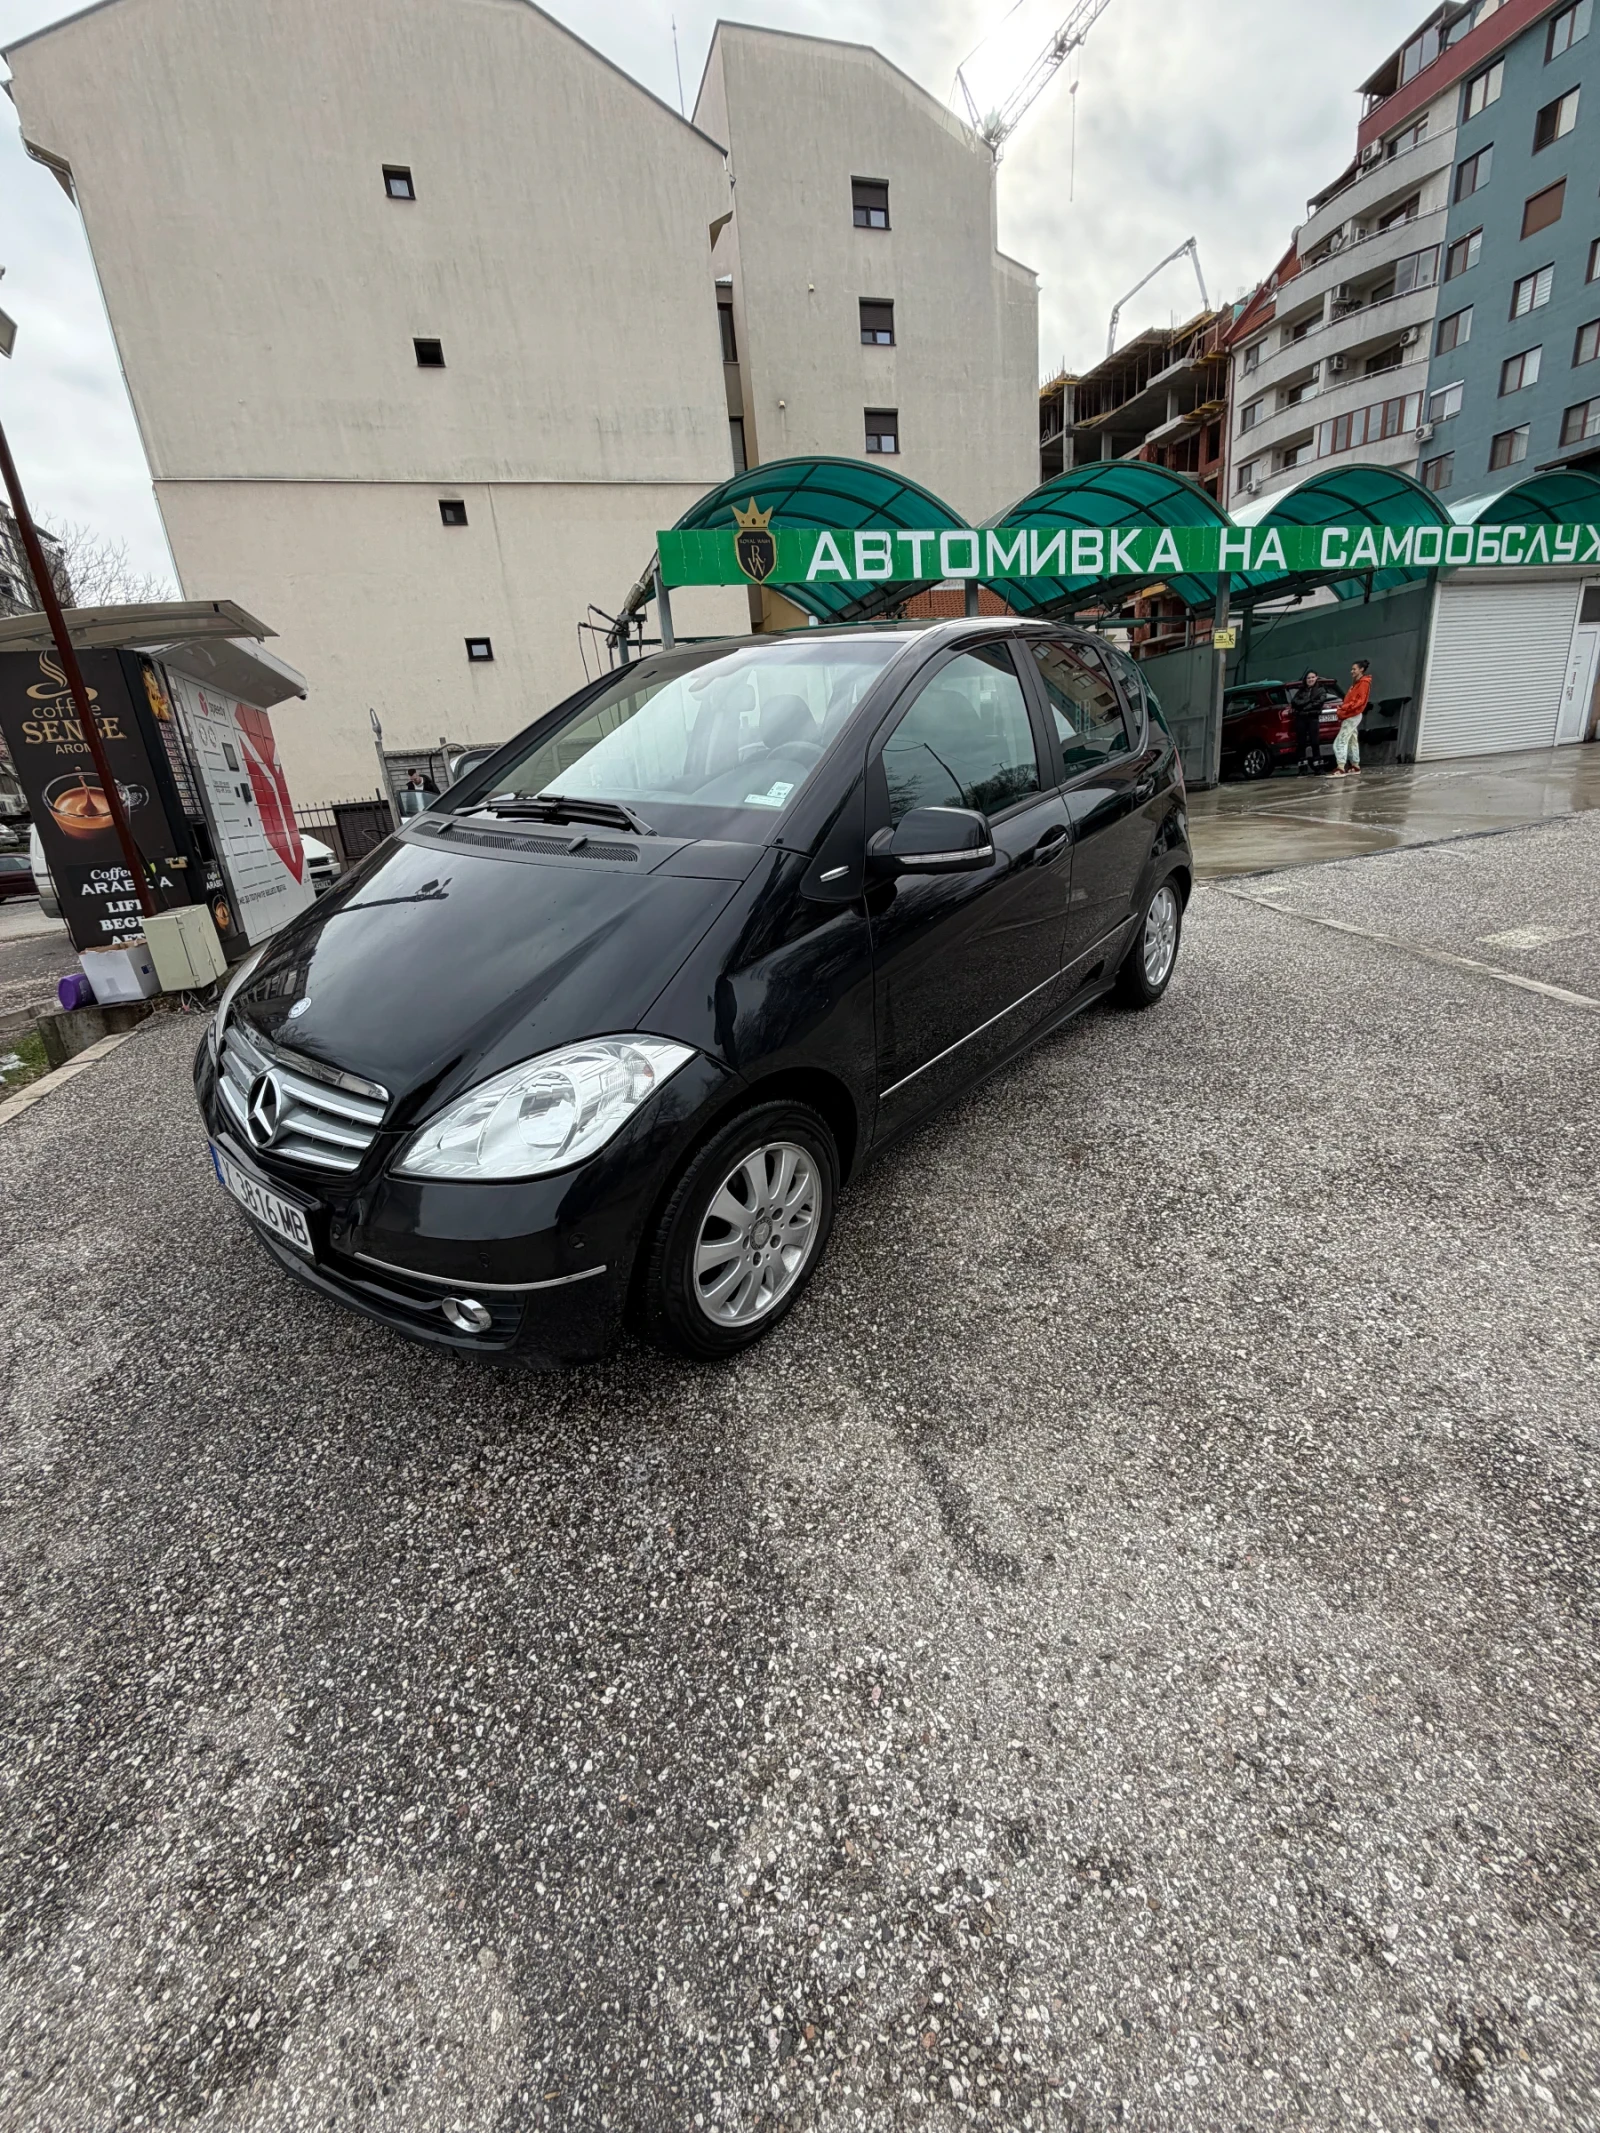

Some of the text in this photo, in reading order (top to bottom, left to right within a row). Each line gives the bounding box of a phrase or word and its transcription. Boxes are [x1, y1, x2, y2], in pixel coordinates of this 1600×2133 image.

[806, 530, 1184, 580] АВТОМИВКА
[1218, 528, 1288, 571] НА
[32, 697, 101, 719] coffe
